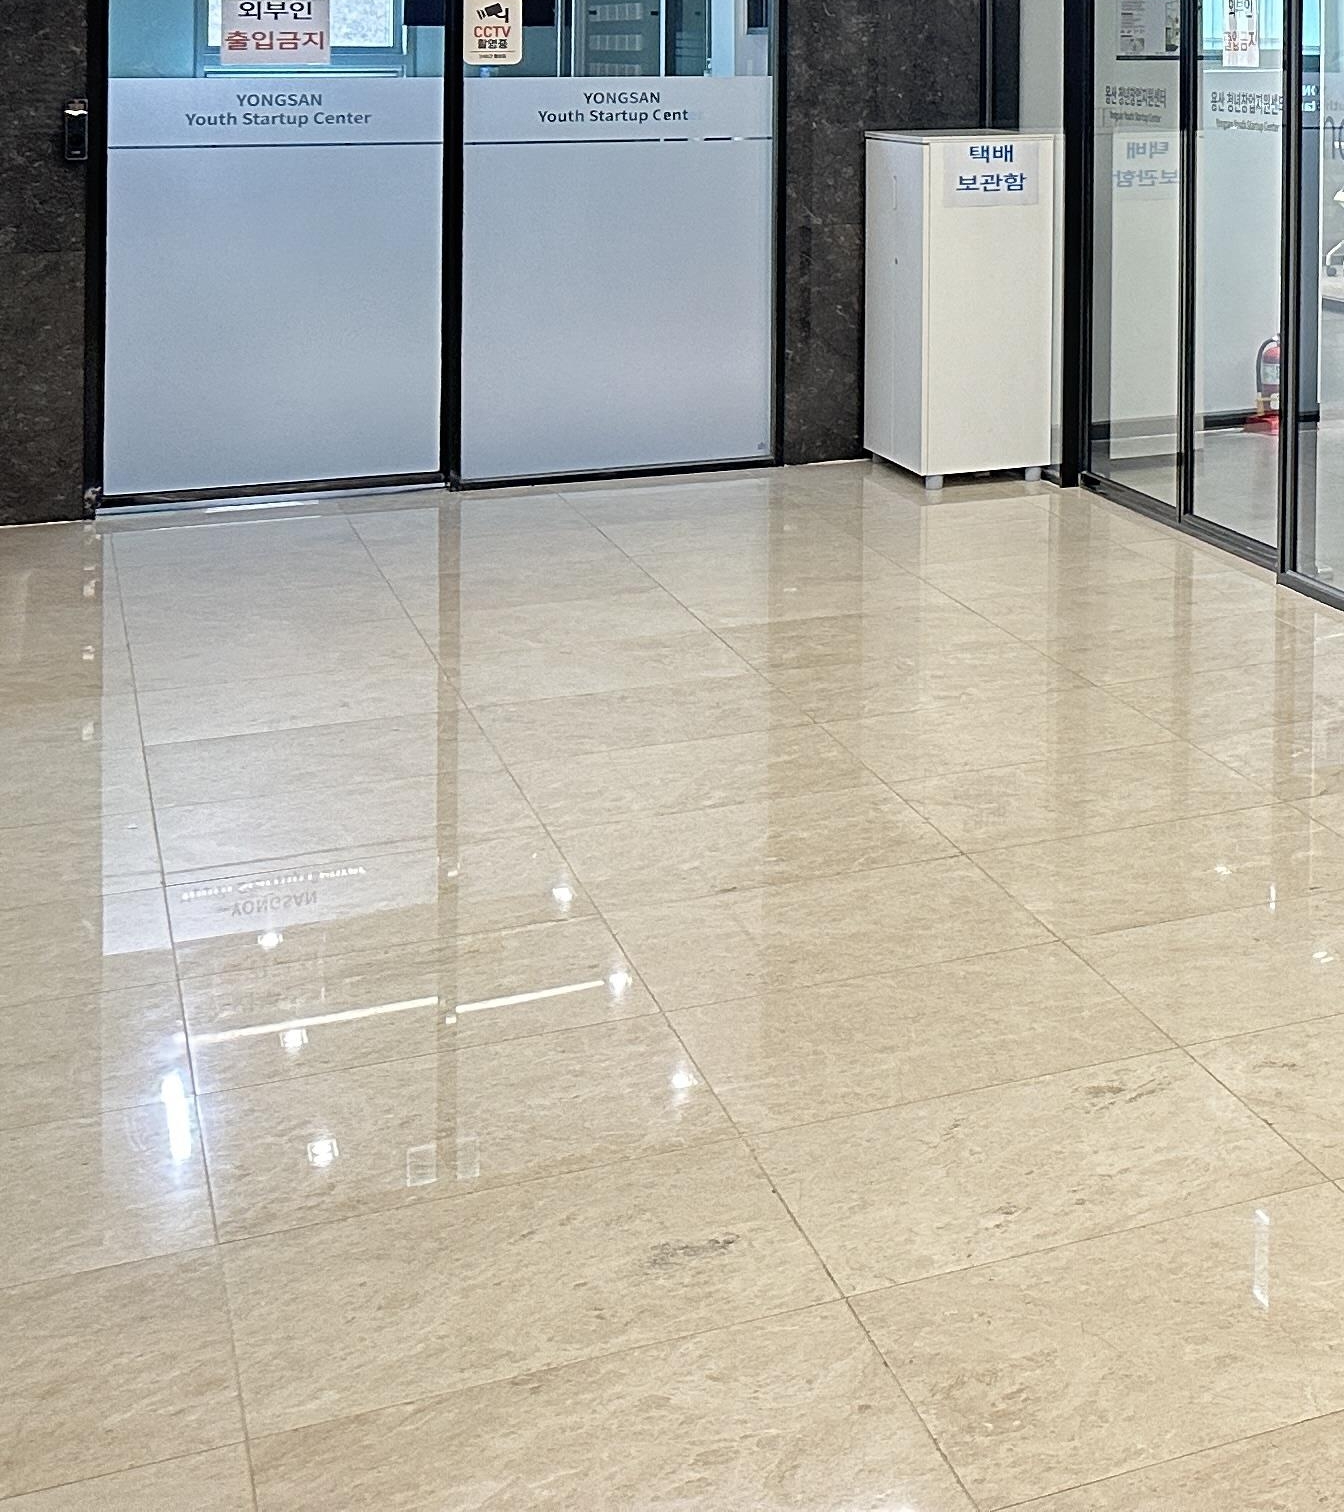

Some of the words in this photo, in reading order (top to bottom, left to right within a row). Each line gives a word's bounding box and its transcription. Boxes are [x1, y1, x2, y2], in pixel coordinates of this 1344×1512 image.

[238, 0, 312, 21] 외부인
[225, 30, 325, 51] 출입금지
[474, 26, 511, 38] CCTV
[236, 93, 323, 107] YONGSAN
[583, 92, 661, 105] YONGSAN
[185, 112, 237, 126] Youth
[242, 111, 309, 128] Startup
[313, 111, 372, 125] Center
[538, 109, 585, 123] Youth
[589, 109, 649, 124] Startup
[969, 144, 1014, 163] 택배
[956, 172, 1027, 192] 보관함
